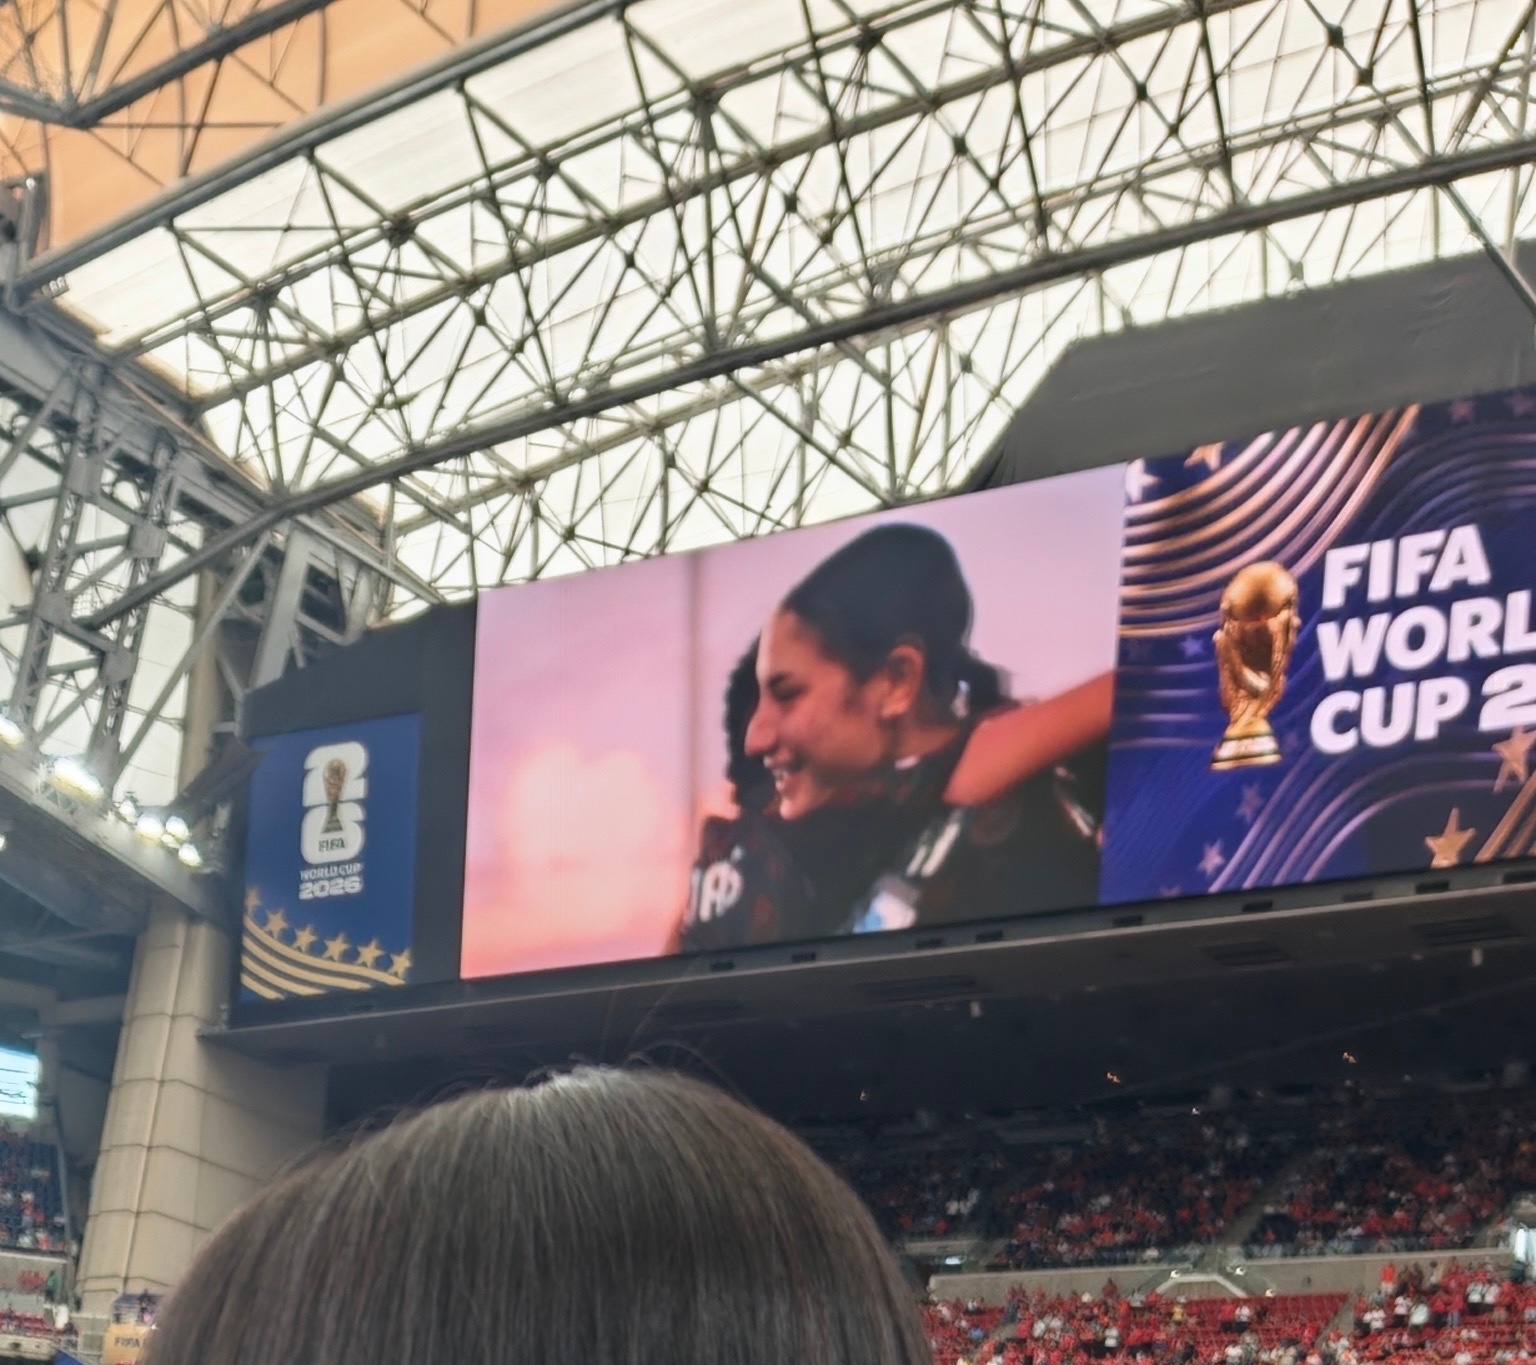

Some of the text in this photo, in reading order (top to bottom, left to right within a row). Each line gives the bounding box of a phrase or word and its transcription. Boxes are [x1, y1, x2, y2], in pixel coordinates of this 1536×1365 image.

[1322, 524, 1491, 610] FIFA
[1311, 676, 1470, 754] CUP
[318, 838, 346, 852] FIFA
[300, 862, 363, 881] WORLD CUP
[298, 877, 363, 900] 2026
